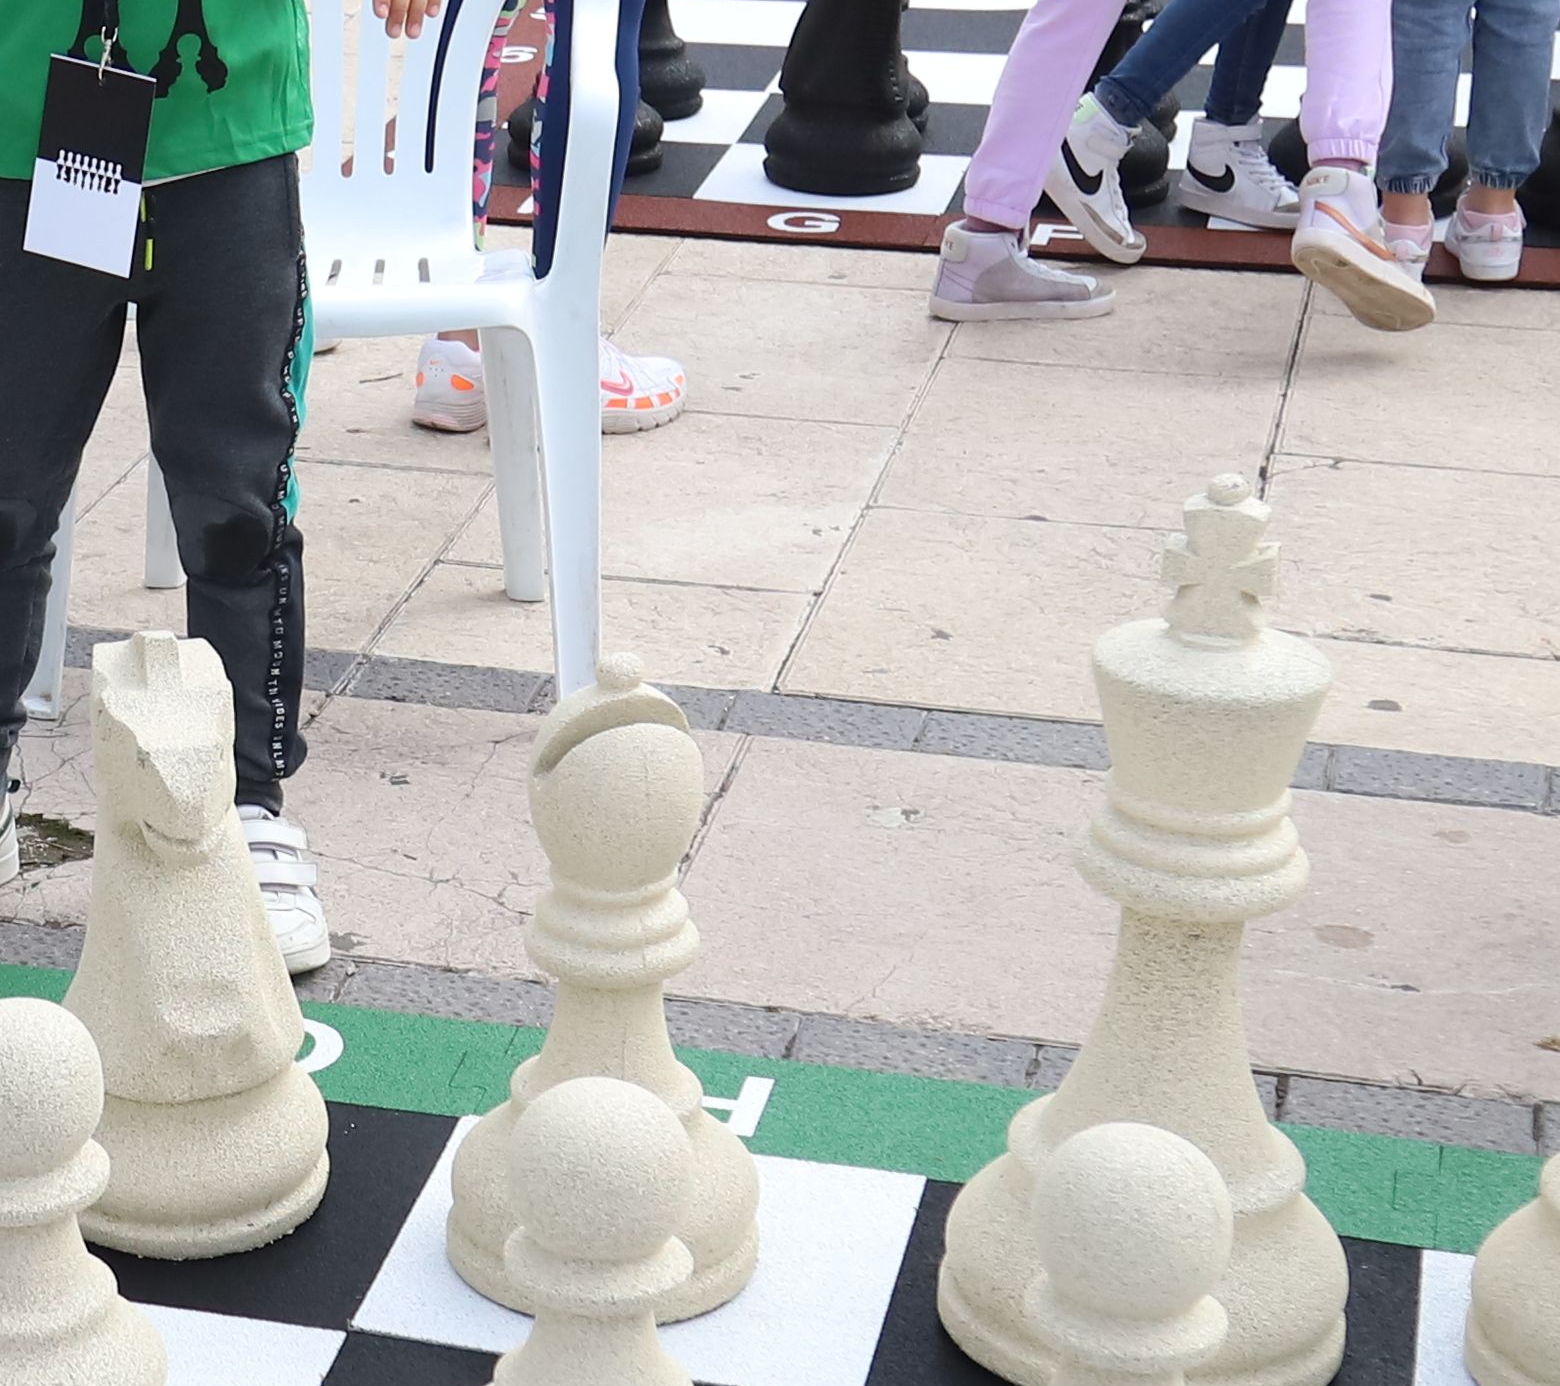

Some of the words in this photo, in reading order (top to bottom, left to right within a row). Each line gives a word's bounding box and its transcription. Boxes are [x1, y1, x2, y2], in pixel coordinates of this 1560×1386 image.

[500, 46, 538, 63] 5
[766, 211, 842, 235] G
[1030, 224, 1085, 246] F
